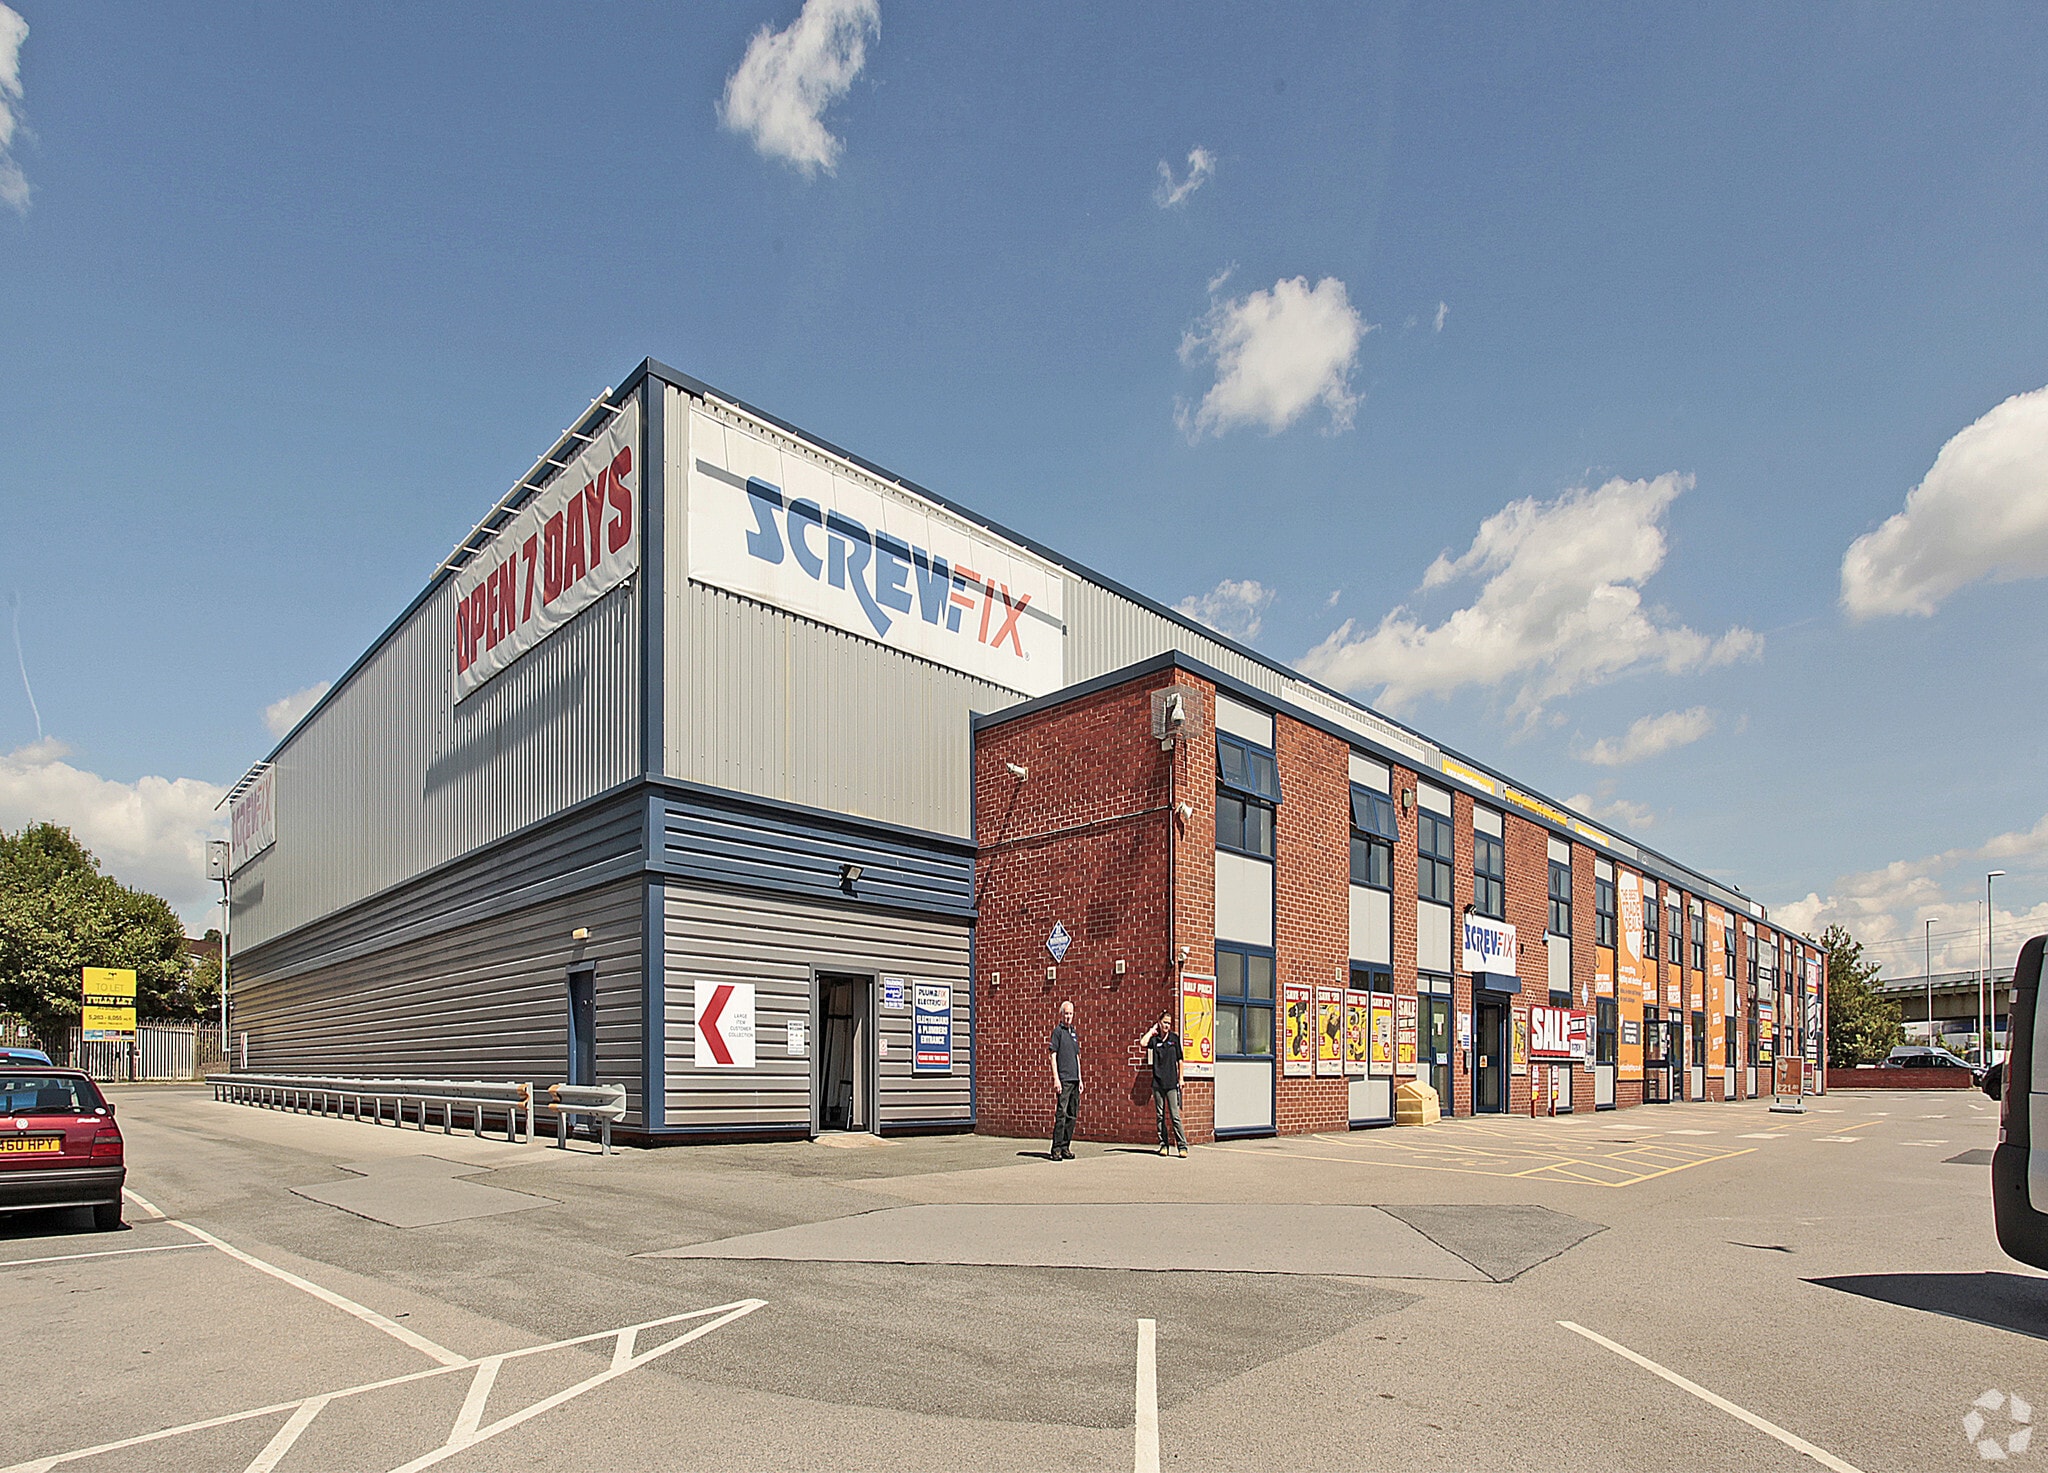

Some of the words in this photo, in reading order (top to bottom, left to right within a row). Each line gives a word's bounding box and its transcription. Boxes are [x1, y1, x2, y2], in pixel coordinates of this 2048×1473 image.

[456, 551, 517, 676] OPEN
[521, 532, 538, 625] 7
[543, 445, 632, 607] DAYS
[745, 475, 1032, 658] SCREWFIX
[1465, 923, 1514, 963] SCREWFIX
[86, 996, 115, 1005] FULLY
[116, 997, 134, 1005] LET
[96, 983, 108, 992] TO
[110, 984, 124, 992] LET
[1398, 1000, 1417, 1016] SALE
[1531, 1007, 1571, 1052] SALE
[28, 1138, 54, 1150] HPY
